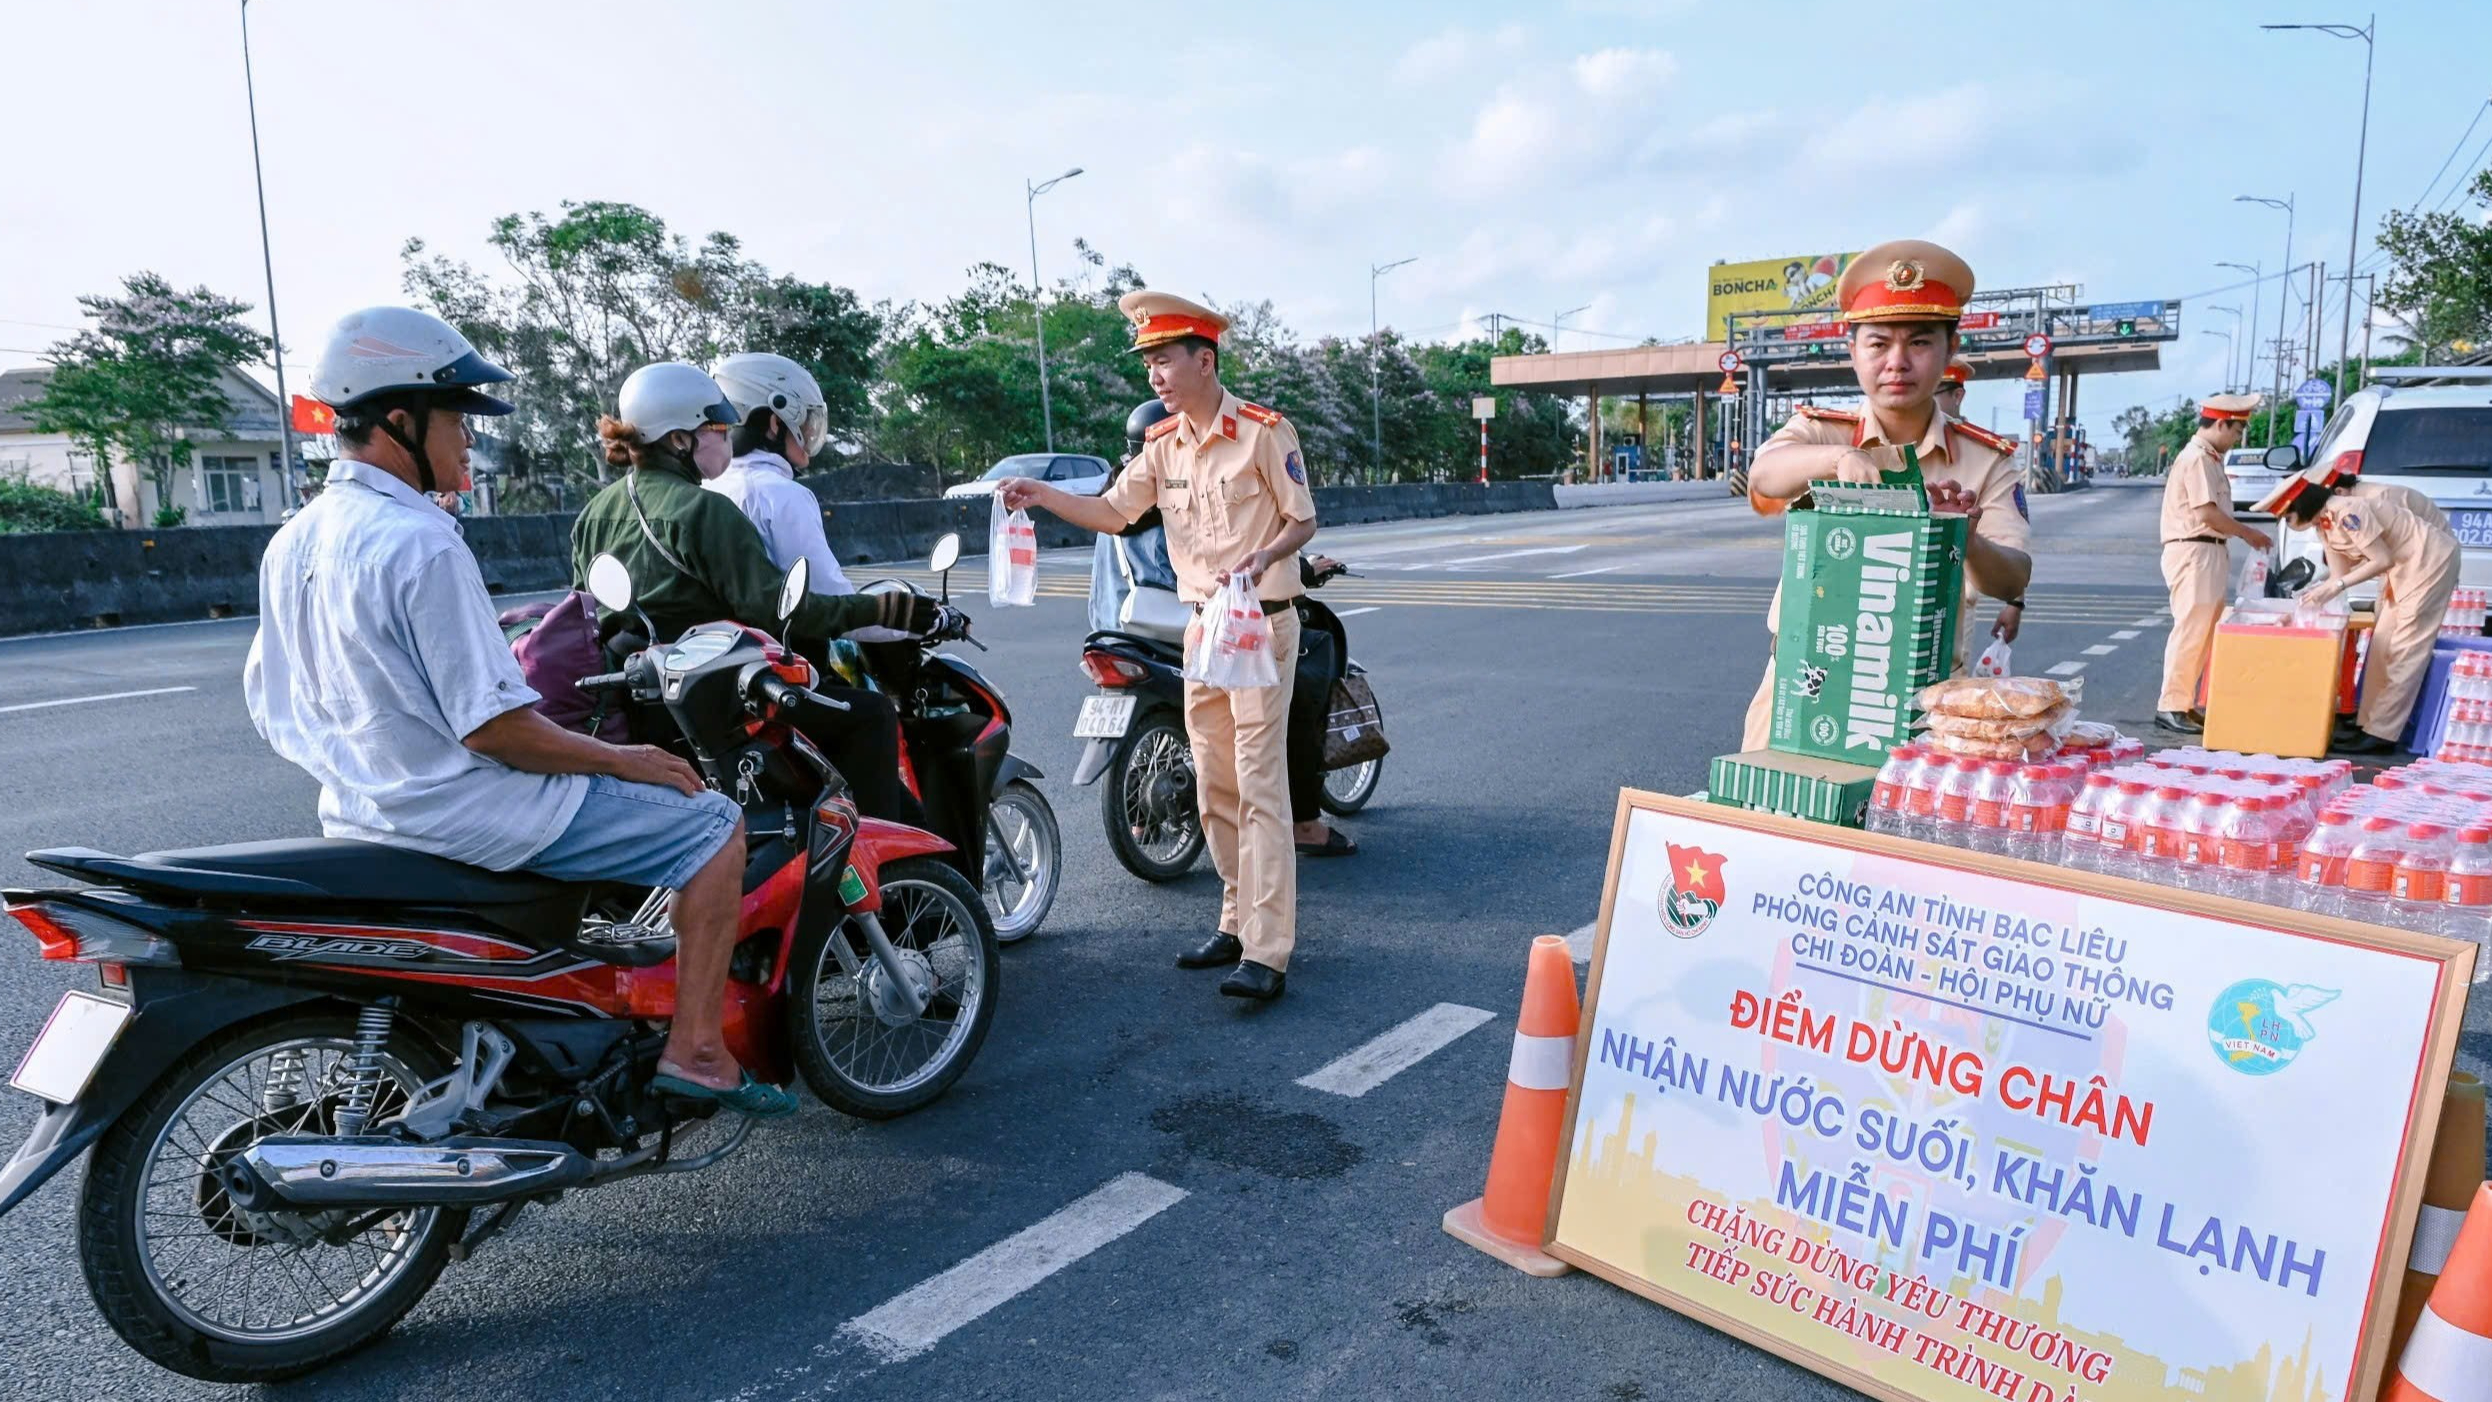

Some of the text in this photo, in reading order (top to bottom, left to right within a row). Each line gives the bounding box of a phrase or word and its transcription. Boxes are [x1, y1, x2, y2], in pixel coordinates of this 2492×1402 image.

[1713, 278, 1776, 296] BONCHA
[1845, 531, 1913, 751] Vinamilk
[246, 934, 428, 960] BLADE
[1752, 892, 2174, 1011] PHÒNG CẢNH SÁT GIAO THÔNG
[1798, 871, 2127, 964] CÔNG AN TỈNH BẠC LIÊU
[1791, 933, 1834, 962] CHI
[1840, 943, 1915, 982] ĐOÀN
[1938, 967, 1988, 1003] HỘI
[1995, 981, 2055, 1022] PHỤ
[2062, 997, 2111, 1029] NỮ
[1730, 989, 2154, 1147] ĐIỂM DỪNG CHÂN
[2253, 1044, 2275, 1058] NAM
[1600, 1028, 2326, 1297] NHẬN NƯỚC SUỐI, KHĂN LẠNH
[1777, 1161, 2026, 1289] MIỄN PHÍ
[1685, 1242, 1751, 1286] TIẾP
[1750, 1271, 1813, 1313] SỨC
[1811, 1295, 1909, 1354] HÀNH
[1912, 1334, 2024, 1401] TRÌNH
[1687, 1199, 2112, 1384] CHẶNG DỪNG YÊU THƯƠNG
